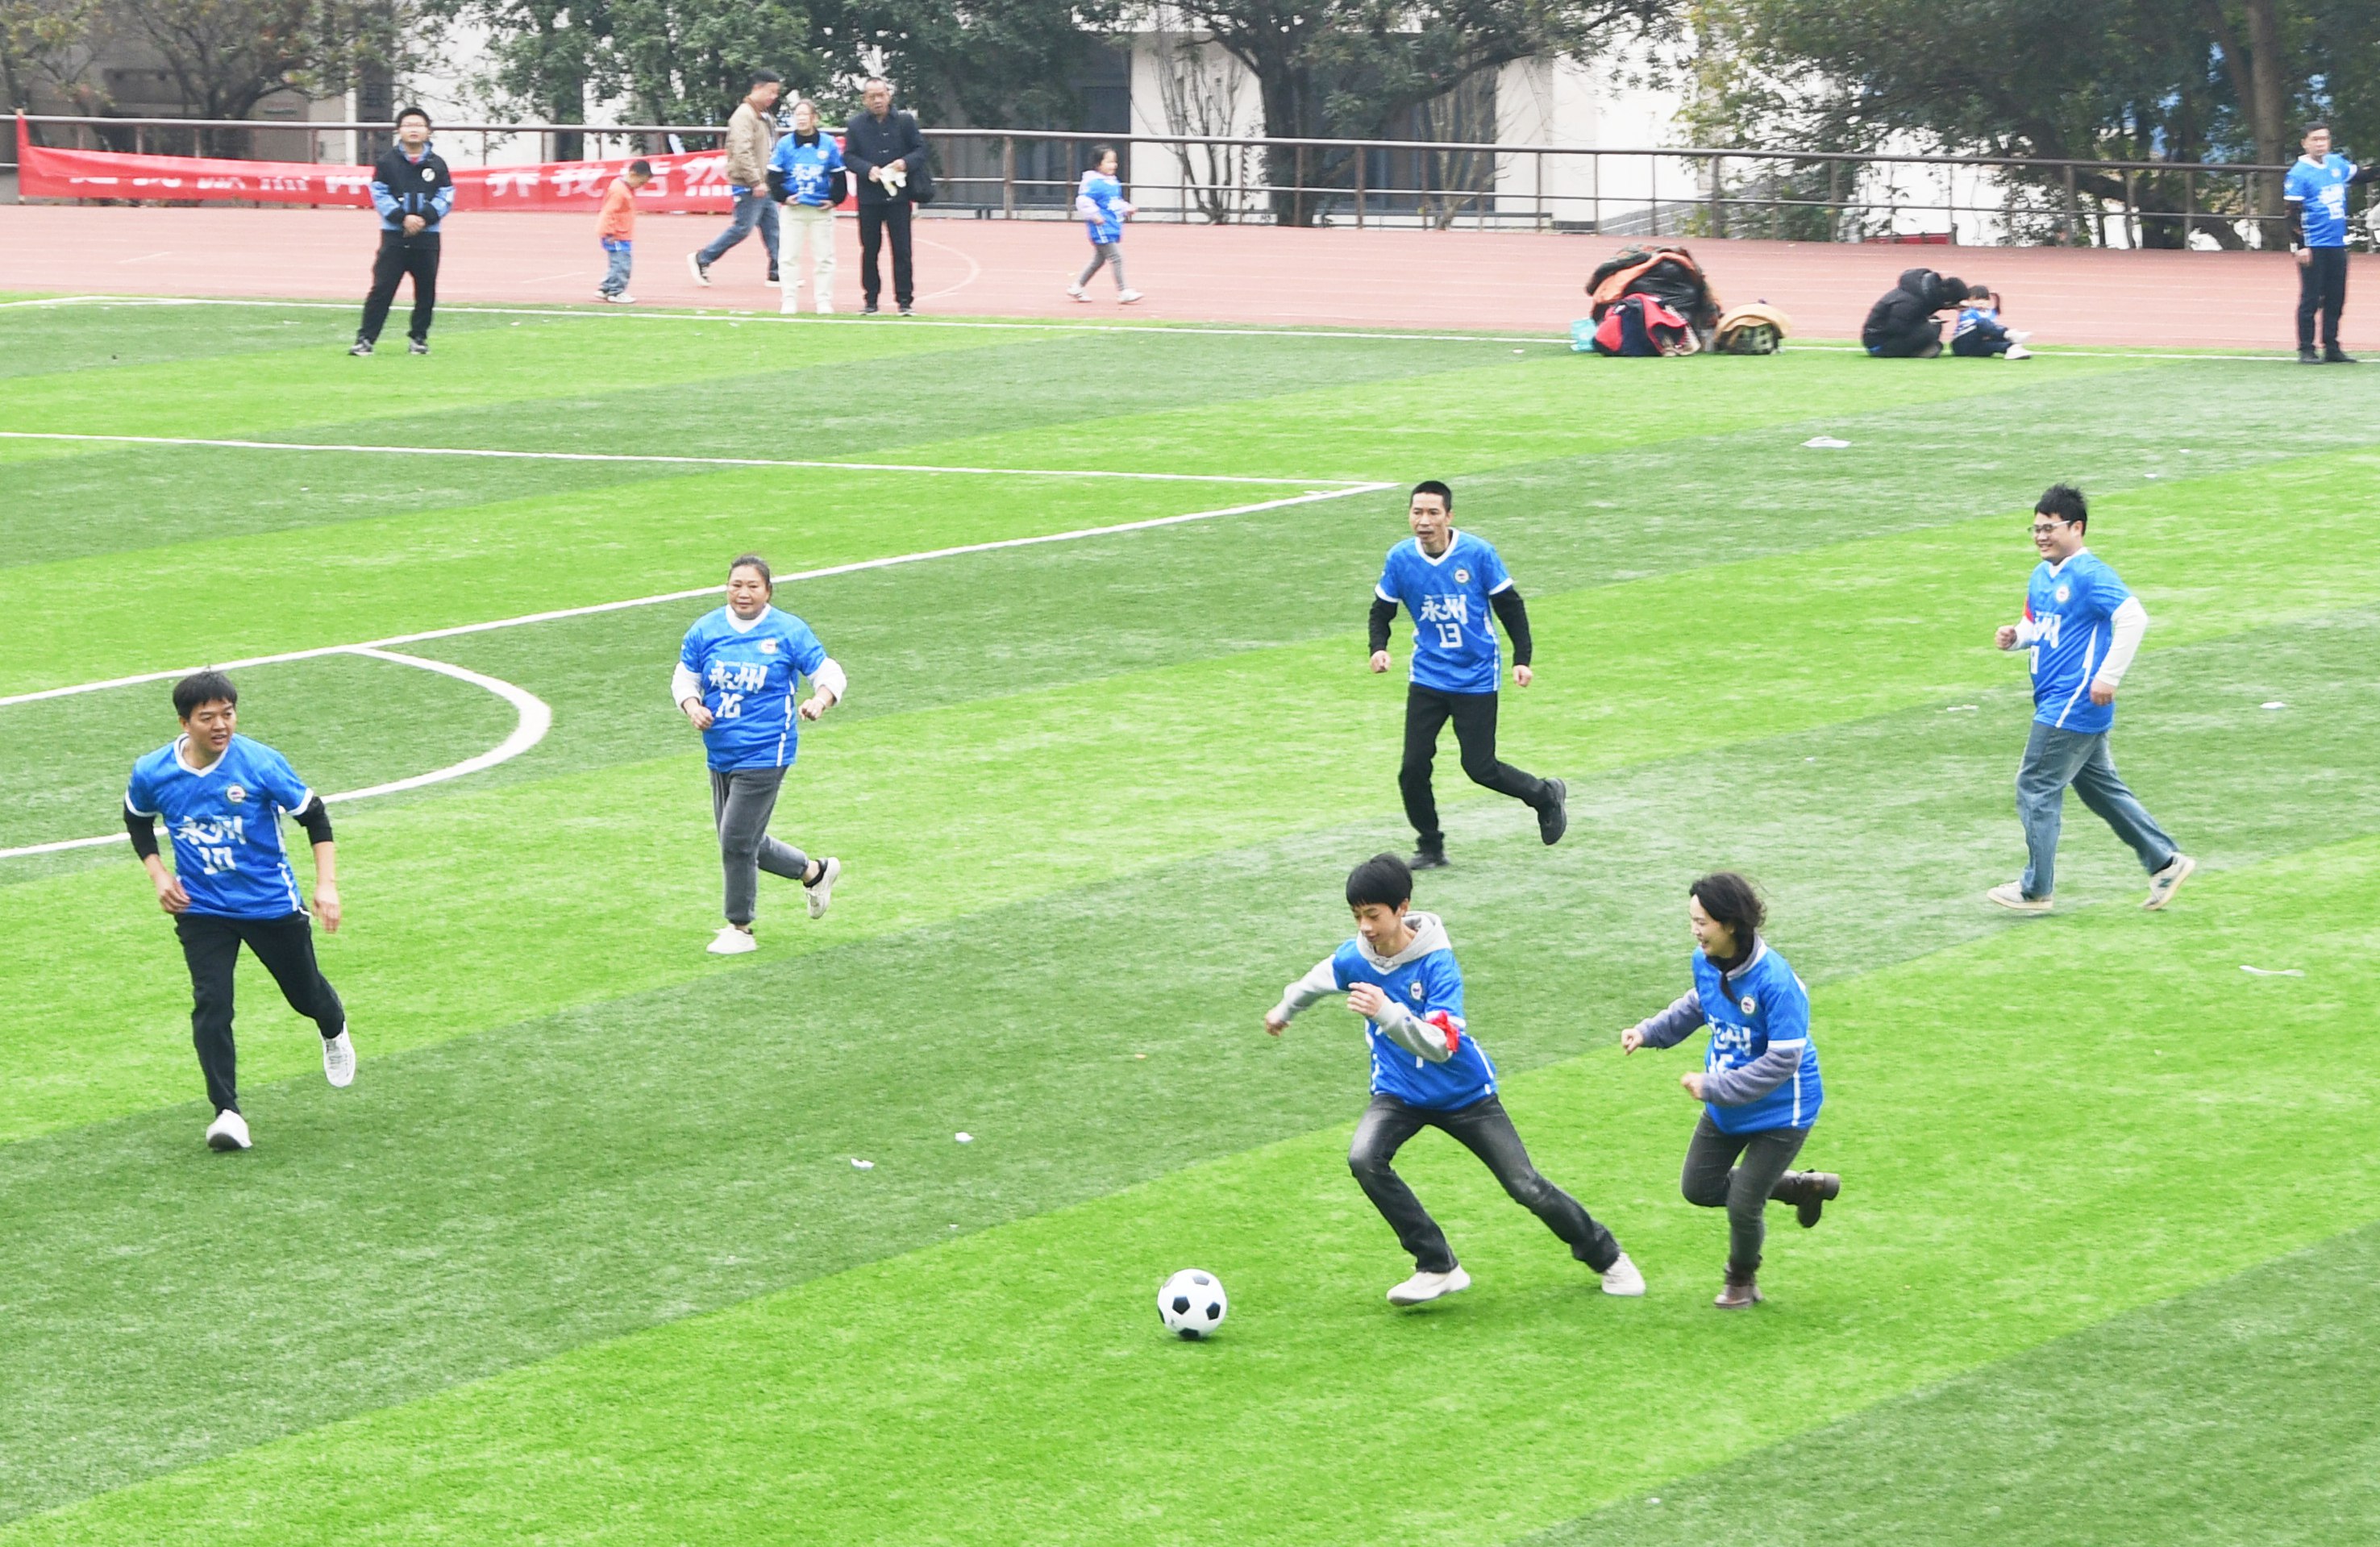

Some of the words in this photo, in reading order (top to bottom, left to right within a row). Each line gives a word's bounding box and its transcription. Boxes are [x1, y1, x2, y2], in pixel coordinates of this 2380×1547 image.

[1419, 593, 1468, 625] 永州
[1435, 622, 1463, 648] 13
[708, 659, 768, 693] 永州
[715, 692, 744, 718] 16
[174, 815, 246, 846] 永州
[198, 846, 236, 875] 10
